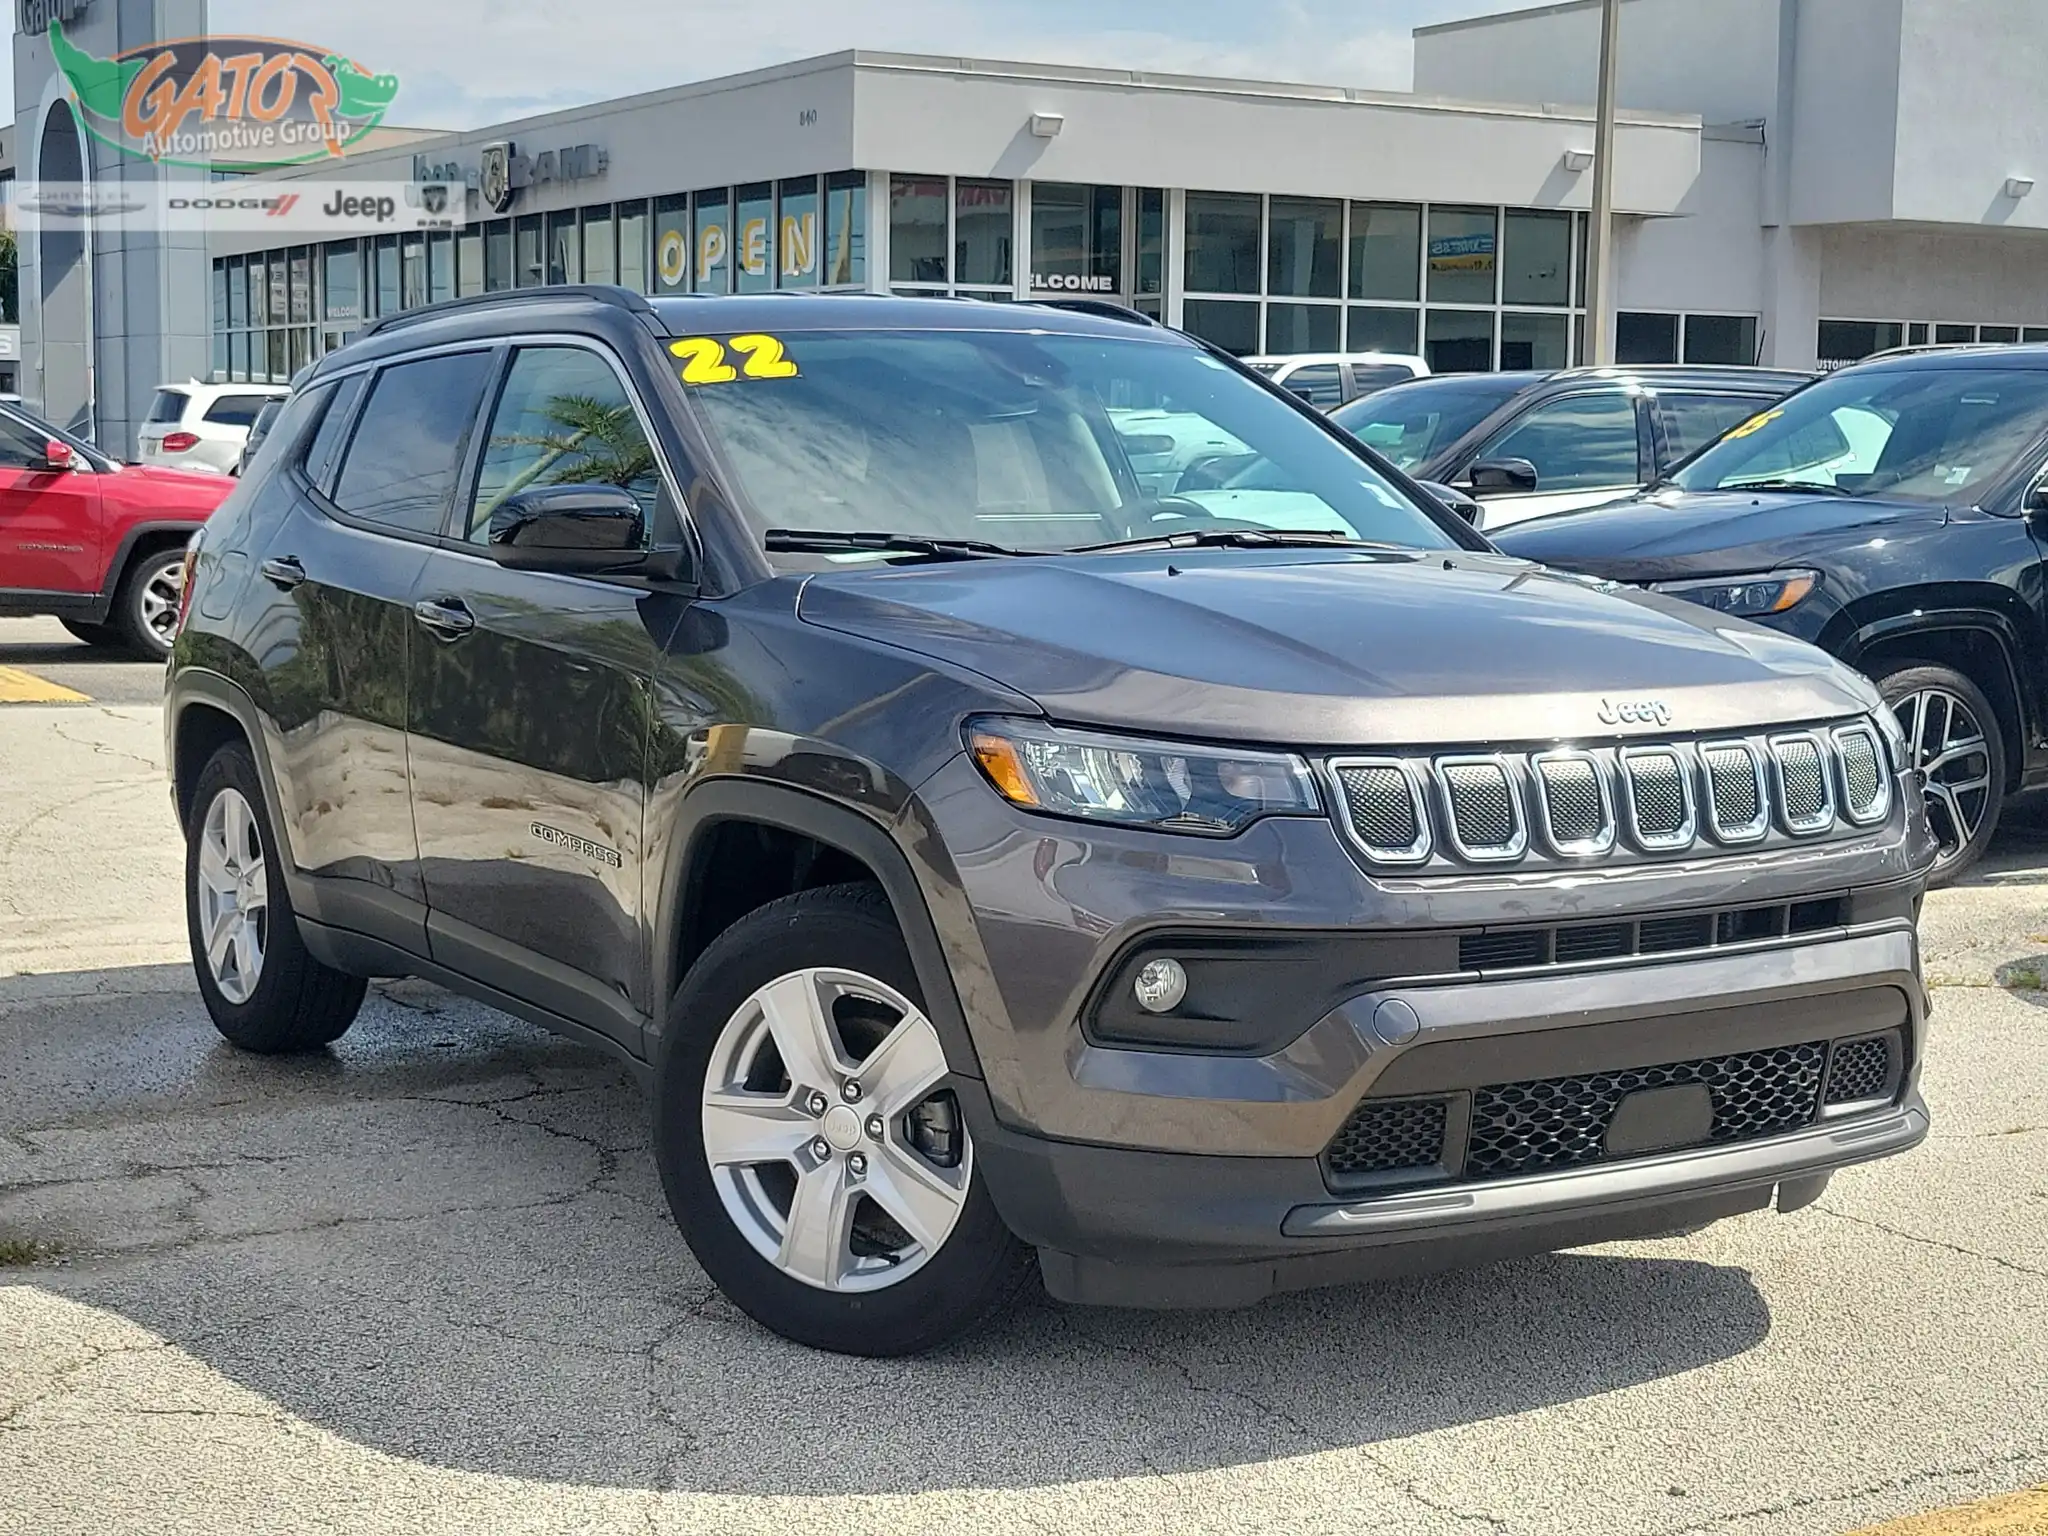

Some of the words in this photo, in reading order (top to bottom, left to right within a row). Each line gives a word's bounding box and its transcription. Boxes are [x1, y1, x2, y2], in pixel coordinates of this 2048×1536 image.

[658, 212, 815, 287] OPEN
[669, 333, 798, 385] 22
[1597, 698, 1672, 726] Jeep
[530, 821, 622, 868] COMPASS
